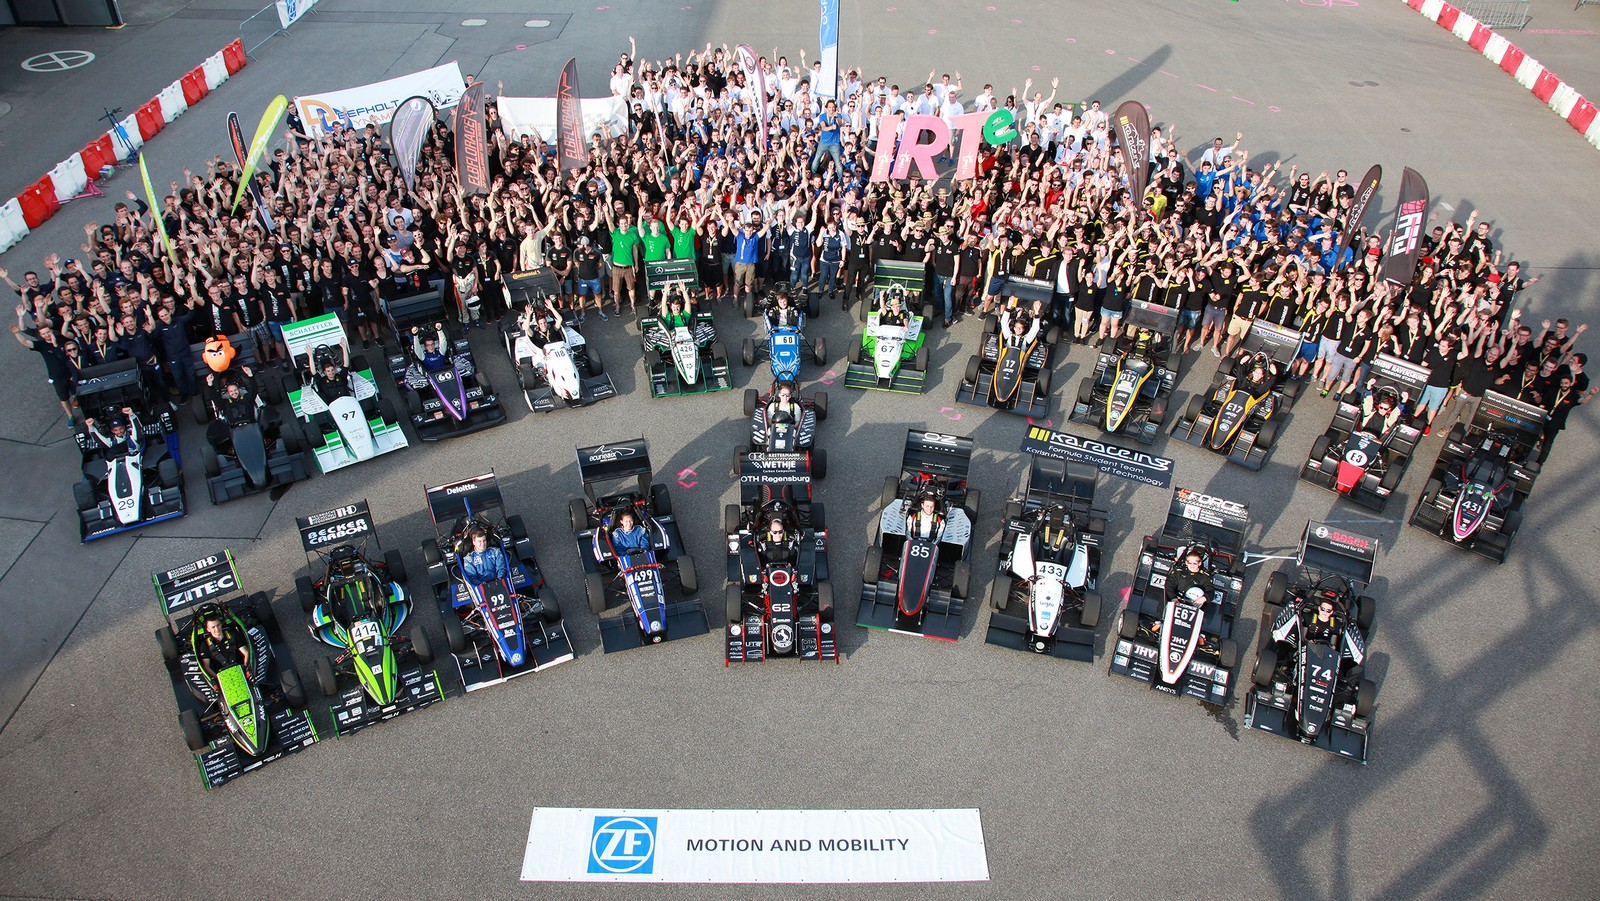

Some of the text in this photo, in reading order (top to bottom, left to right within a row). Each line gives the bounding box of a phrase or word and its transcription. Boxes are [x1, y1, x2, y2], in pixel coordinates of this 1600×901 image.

[289, 321, 334, 337] SCHAEFFLER
[782, 336, 793, 344] 60
[554, 350, 566, 358] 118
[881, 345, 895, 353] 67
[1005, 359, 1016, 368] 17
[438, 372, 452, 381] 60
[1120, 373, 1137, 382] 017
[1225, 402, 1243, 413] E17
[341, 410, 356, 421] 97
[762, 460, 796, 470] WETHJE
[1048, 446, 1144, 474] Formula Student Team
[1108, 467, 1164, 487] Technology
[118, 498, 135, 511] 29
[1461, 500, 1482, 514] 431
[308, 518, 366, 540] BECKER
[309, 524, 368, 545] CARBON
[1331, 532, 1369, 549] BOSCH
[910, 545, 930, 558] 85
[633, 570, 653, 582] 499
[1038, 564, 1063, 578] 433
[167, 574, 234, 609] ZITEC
[490, 594, 505, 606] 99
[771, 603, 791, 612] 62
[1174, 607, 1197, 622] E67
[354, 623, 379, 638] 414
[1134, 645, 1158, 659] JHV
[1191, 662, 1216, 676] JHV
[1311, 664, 1332, 681] 74
[1155, 684, 1177, 695] ANSYS
[598, 828, 650, 862] ZF
[686, 838, 911, 853] MOTION AND MOBILITY
